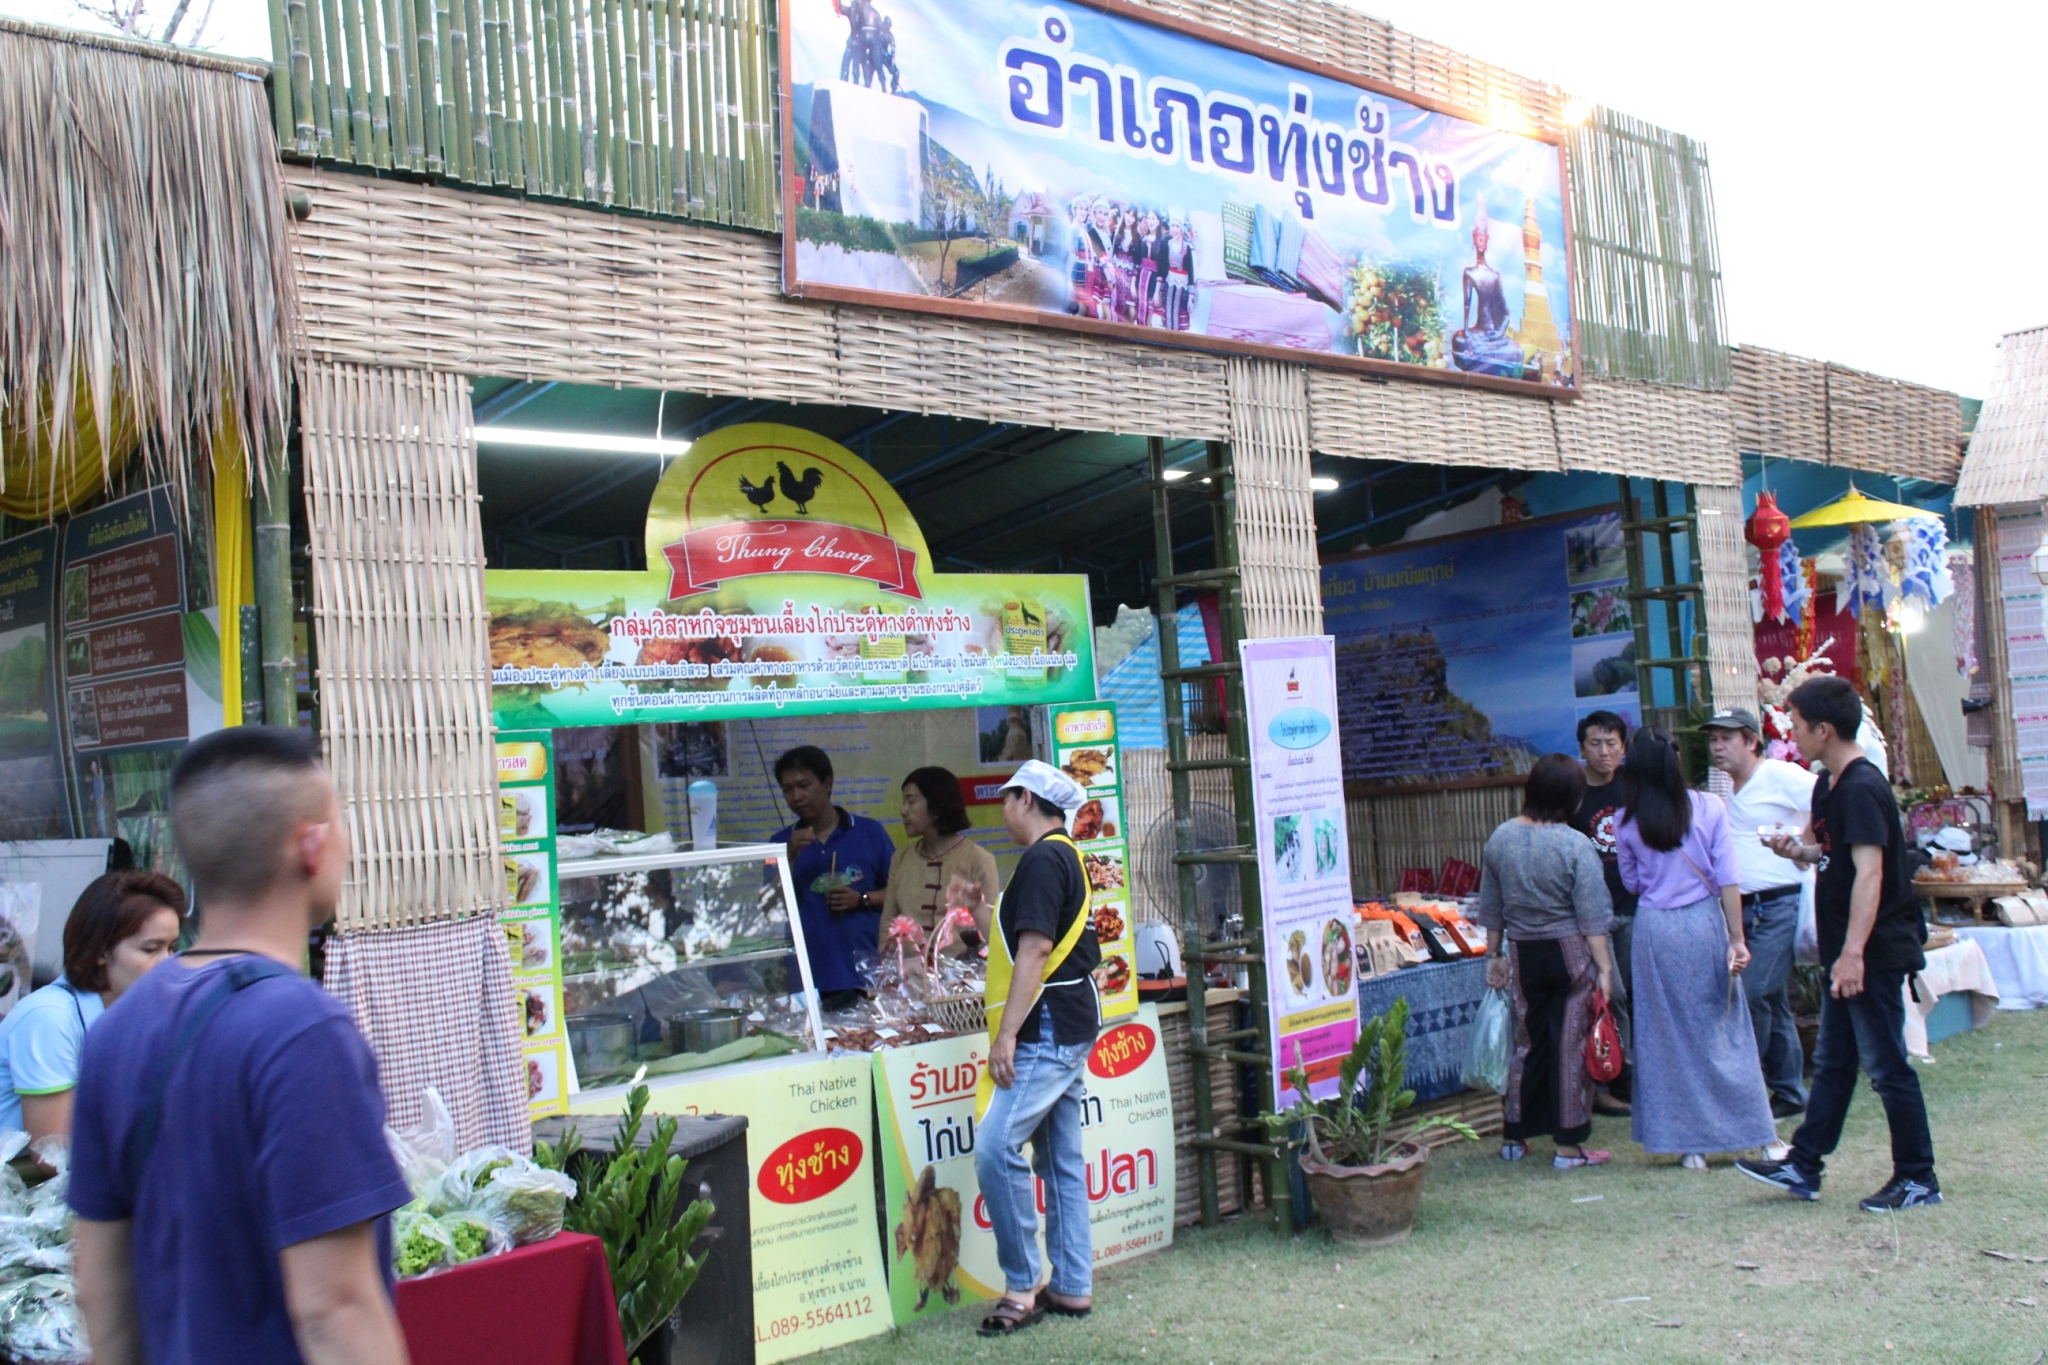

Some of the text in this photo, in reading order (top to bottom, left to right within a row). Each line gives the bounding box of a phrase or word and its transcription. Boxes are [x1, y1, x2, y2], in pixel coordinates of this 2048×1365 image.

[1004, 16, 1456, 222] อำเภอทุ่งช้าง
[716, 523, 875, 573] Thung Chang
[611, 599, 971, 645] กลุ่มวิสาหกิจชุมชนเลี้ยงไก่ประดู่หางดำทุ่งช้าง
[599, 660, 708, 680] เลี้ยงแบบปล่อยอิสระ
[711, 654, 909, 680] เสริมคุณค่าทางอาหารด้วยวัตถุดิบธรรมชาติ
[911, 653, 957, 675] มีโปรตีนสูง
[958, 649, 992, 669] ไขมันต่ำ
[994, 651, 1028, 667] หนังบาง
[1030, 647, 1063, 666] เนื้อแน่น
[1064, 650, 1077, 670] นุ่ม
[611, 678, 982, 714] ทุกขั้นตอนผ่านกระบวนการผลิตที่ถูกหลักอนามัยและตามมาตรฐานของกรมปศุสัตว์
[1064, 716, 1107, 733] อาหารสำเร็จ
[498, 757, 528, 769] ารสด
[1097, 1030, 1147, 1076] ทุ่งช้าง
[789, 1076, 857, 1098] Thai Native
[1110, 1089, 1166, 1111] Thai Native
[809, 1096, 857, 1114] Chicken
[1127, 1107, 1169, 1125] Chicken
[776, 1141, 850, 1195] ทุ่งช้าง
[751, 1204, 857, 1237] ค่าทางอาหารด้วยวัตถุดิบธรรมชาติ
[1092, 1231, 1164, 1262] EL.089-5564112
[754, 1249, 863, 1293] เลี้ยงไก่ประดู่หางดำทุ่งช้าง
[799, 1272, 866, 1304] อ.ทุ่งช้าง จ.น่าน
[755, 1296, 873, 1343] L.089-5564112
